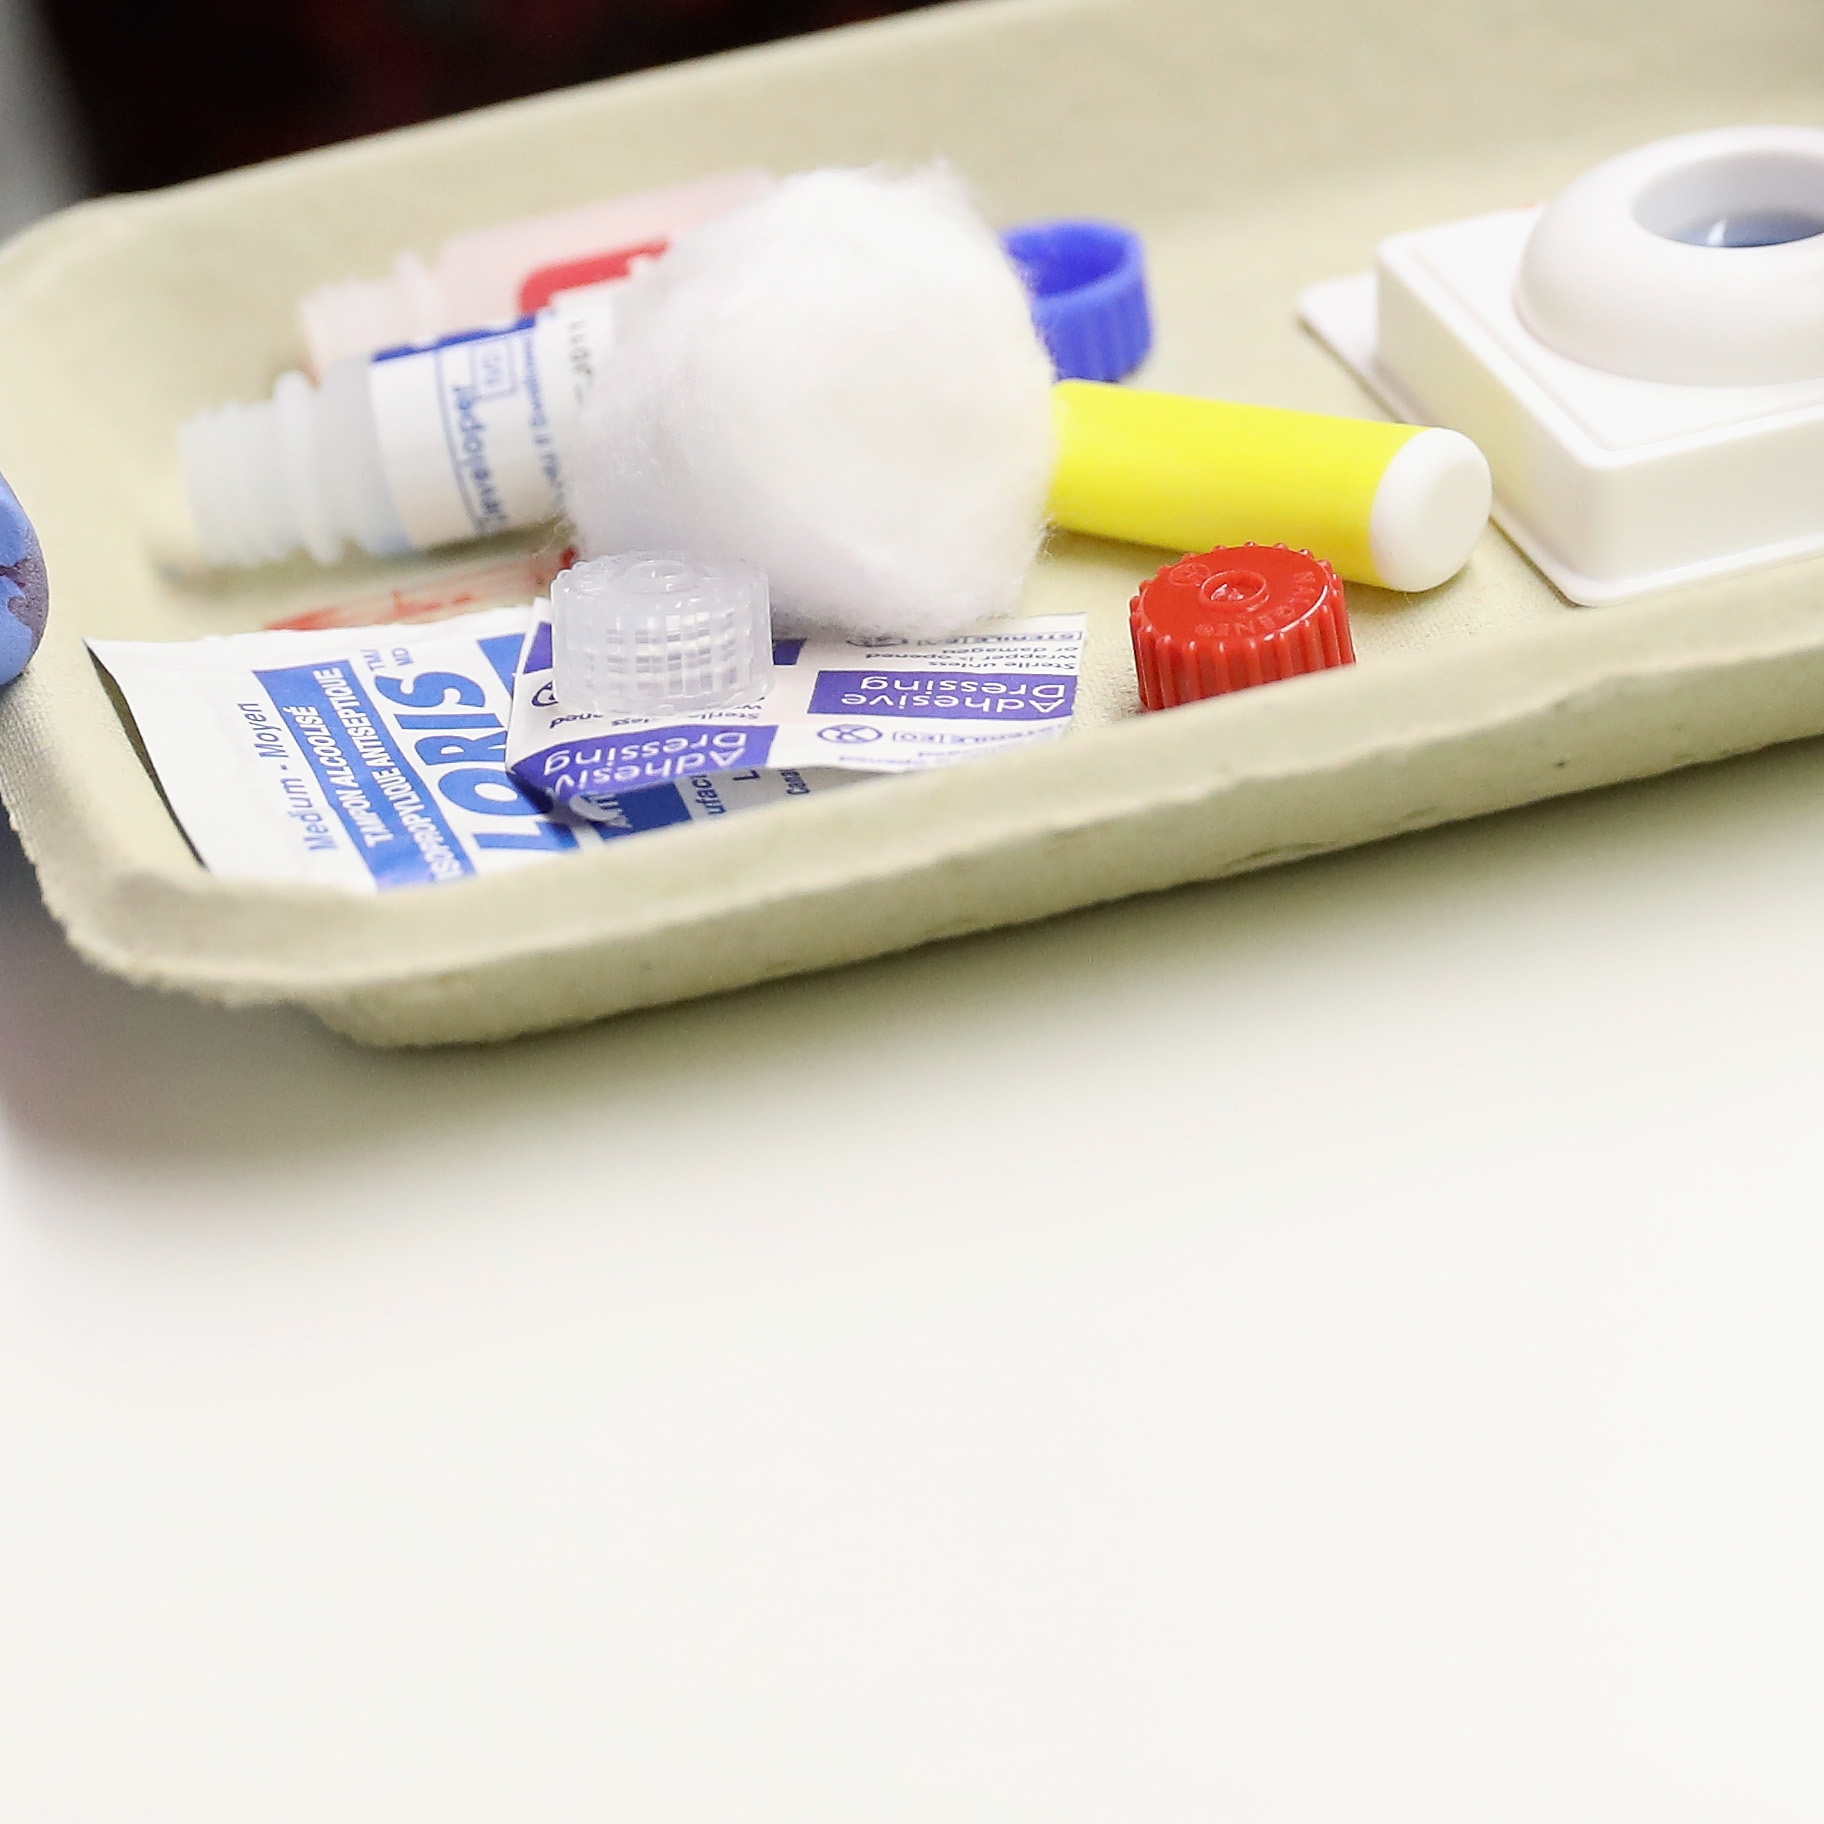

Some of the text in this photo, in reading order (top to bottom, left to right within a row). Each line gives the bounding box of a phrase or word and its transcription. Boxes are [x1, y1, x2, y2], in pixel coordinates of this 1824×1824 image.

[840, 691, 1066, 714] Adhesive
[859, 676, 1066, 698] Dressing
[236, 702, 289, 759] Moyen
[312, 666, 388, 767] ANTISEPTIQUE
[281, 704, 394, 849] TAMPON ALCOOLISÉ
[374, 670, 580, 851] LORIS
[543, 730, 748, 777] Dressing
